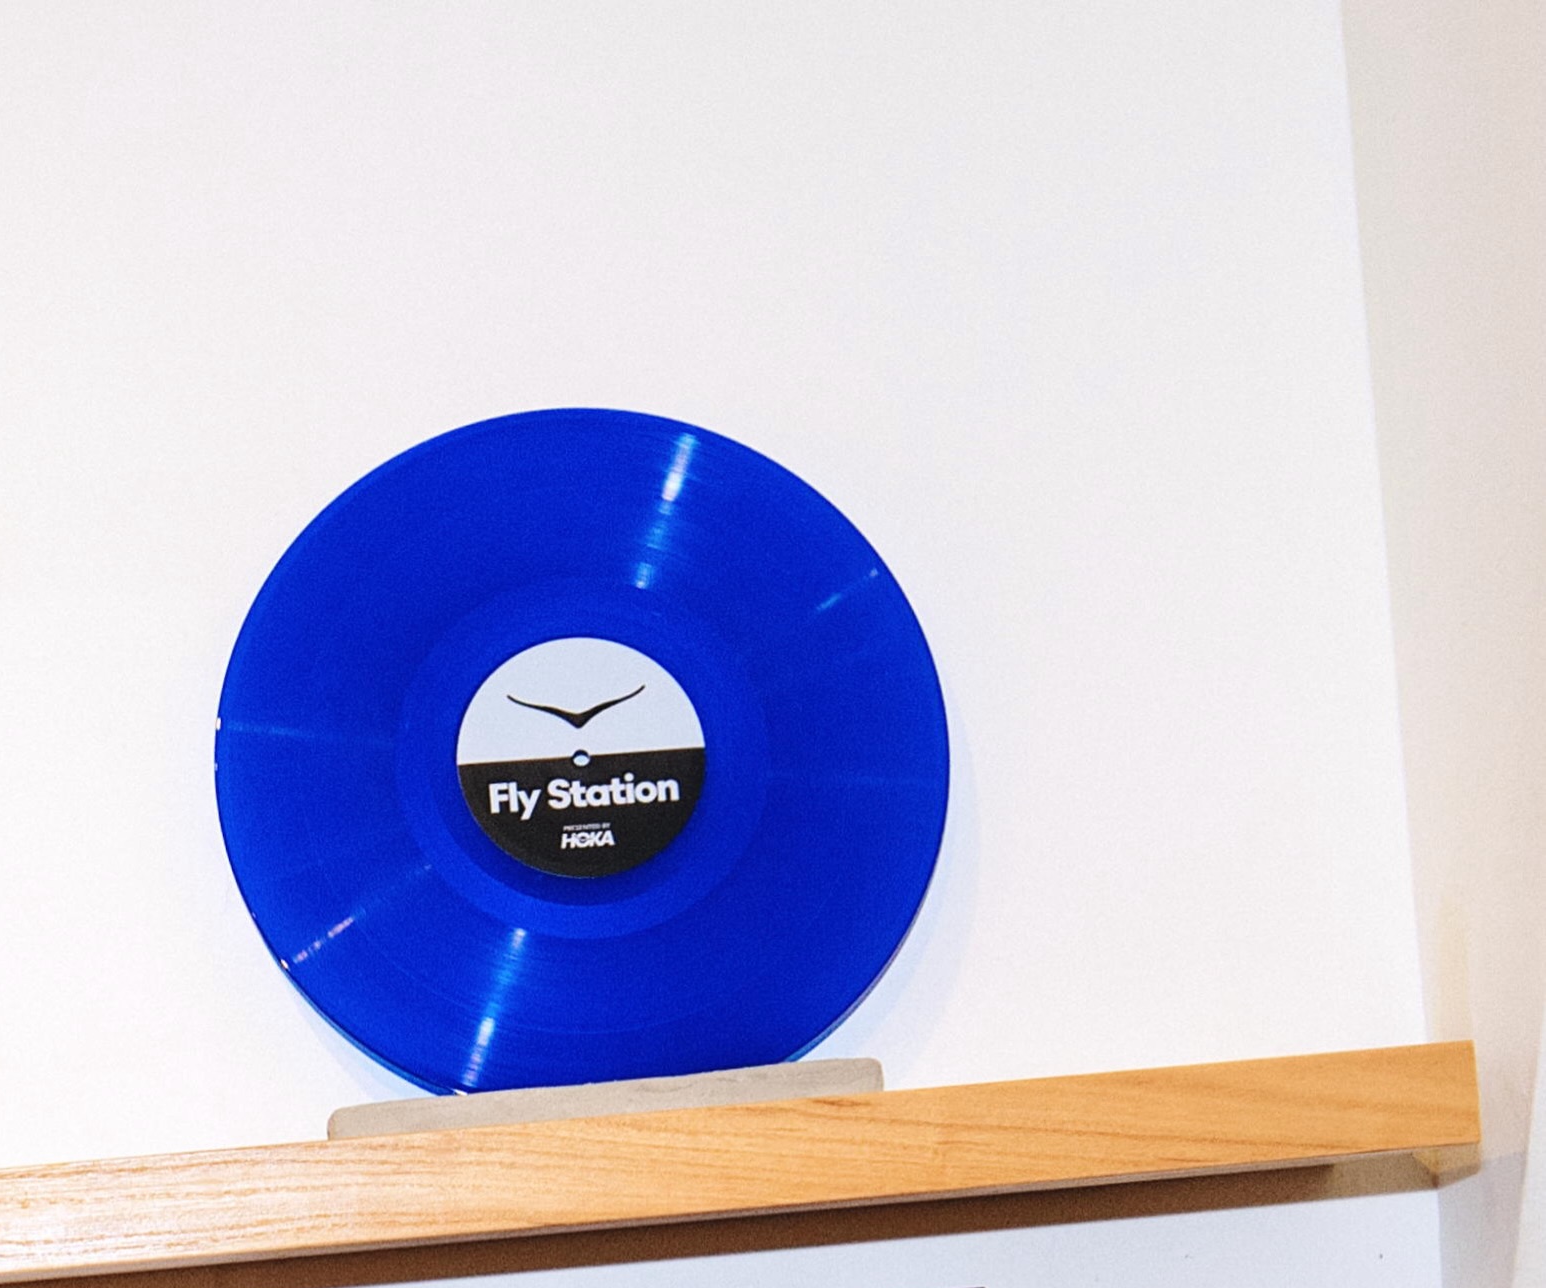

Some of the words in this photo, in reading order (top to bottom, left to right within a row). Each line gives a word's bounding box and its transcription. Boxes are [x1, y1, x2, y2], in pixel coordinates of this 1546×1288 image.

[488, 781, 541, 821] Fly
[547, 772, 680, 809] Station
[560, 829, 615, 849] HOKA
